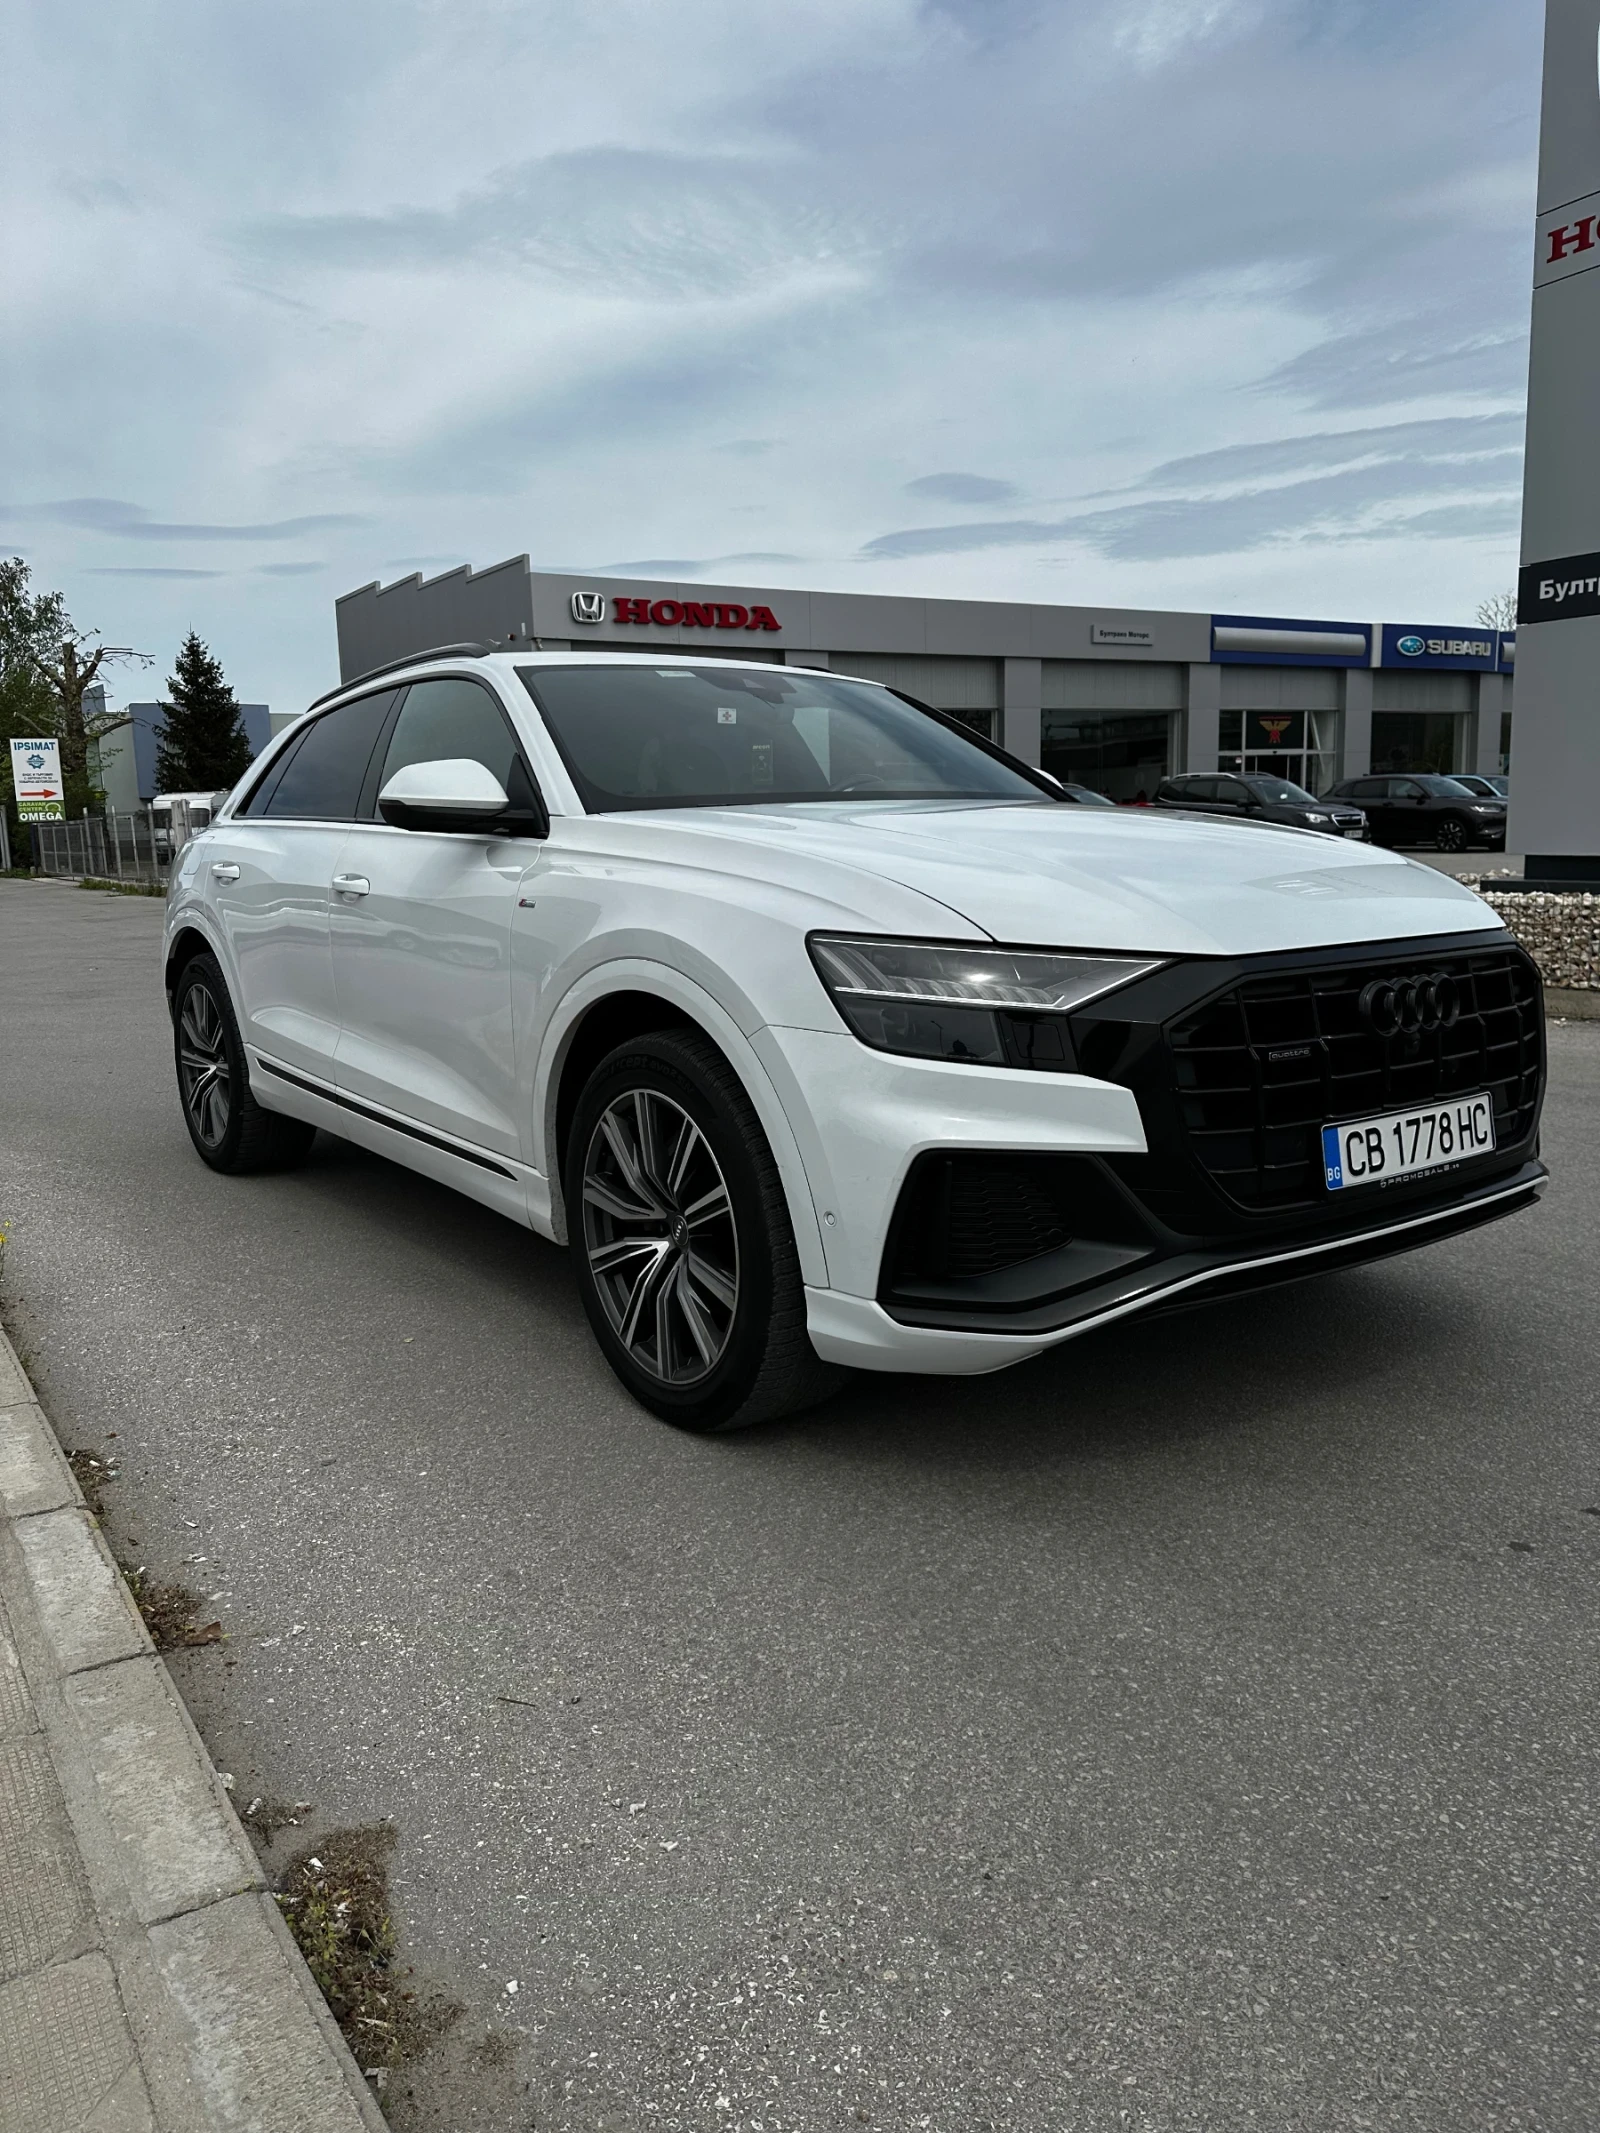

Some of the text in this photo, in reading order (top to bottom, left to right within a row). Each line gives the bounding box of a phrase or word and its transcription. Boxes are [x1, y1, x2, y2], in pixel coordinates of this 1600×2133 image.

[1546, 215, 1600, 264] H
[1539, 576, 1600, 602] Булт
[613, 598, 782, 630] HONDA
[1427, 639, 1491, 657] SUBARU
[14, 742, 55, 750] IPSIMAT
[19, 812, 63, 821] OMEGA
[1345, 1102, 1488, 1177] CB 1778 HC
[1327, 1166, 1341, 1182] BG
